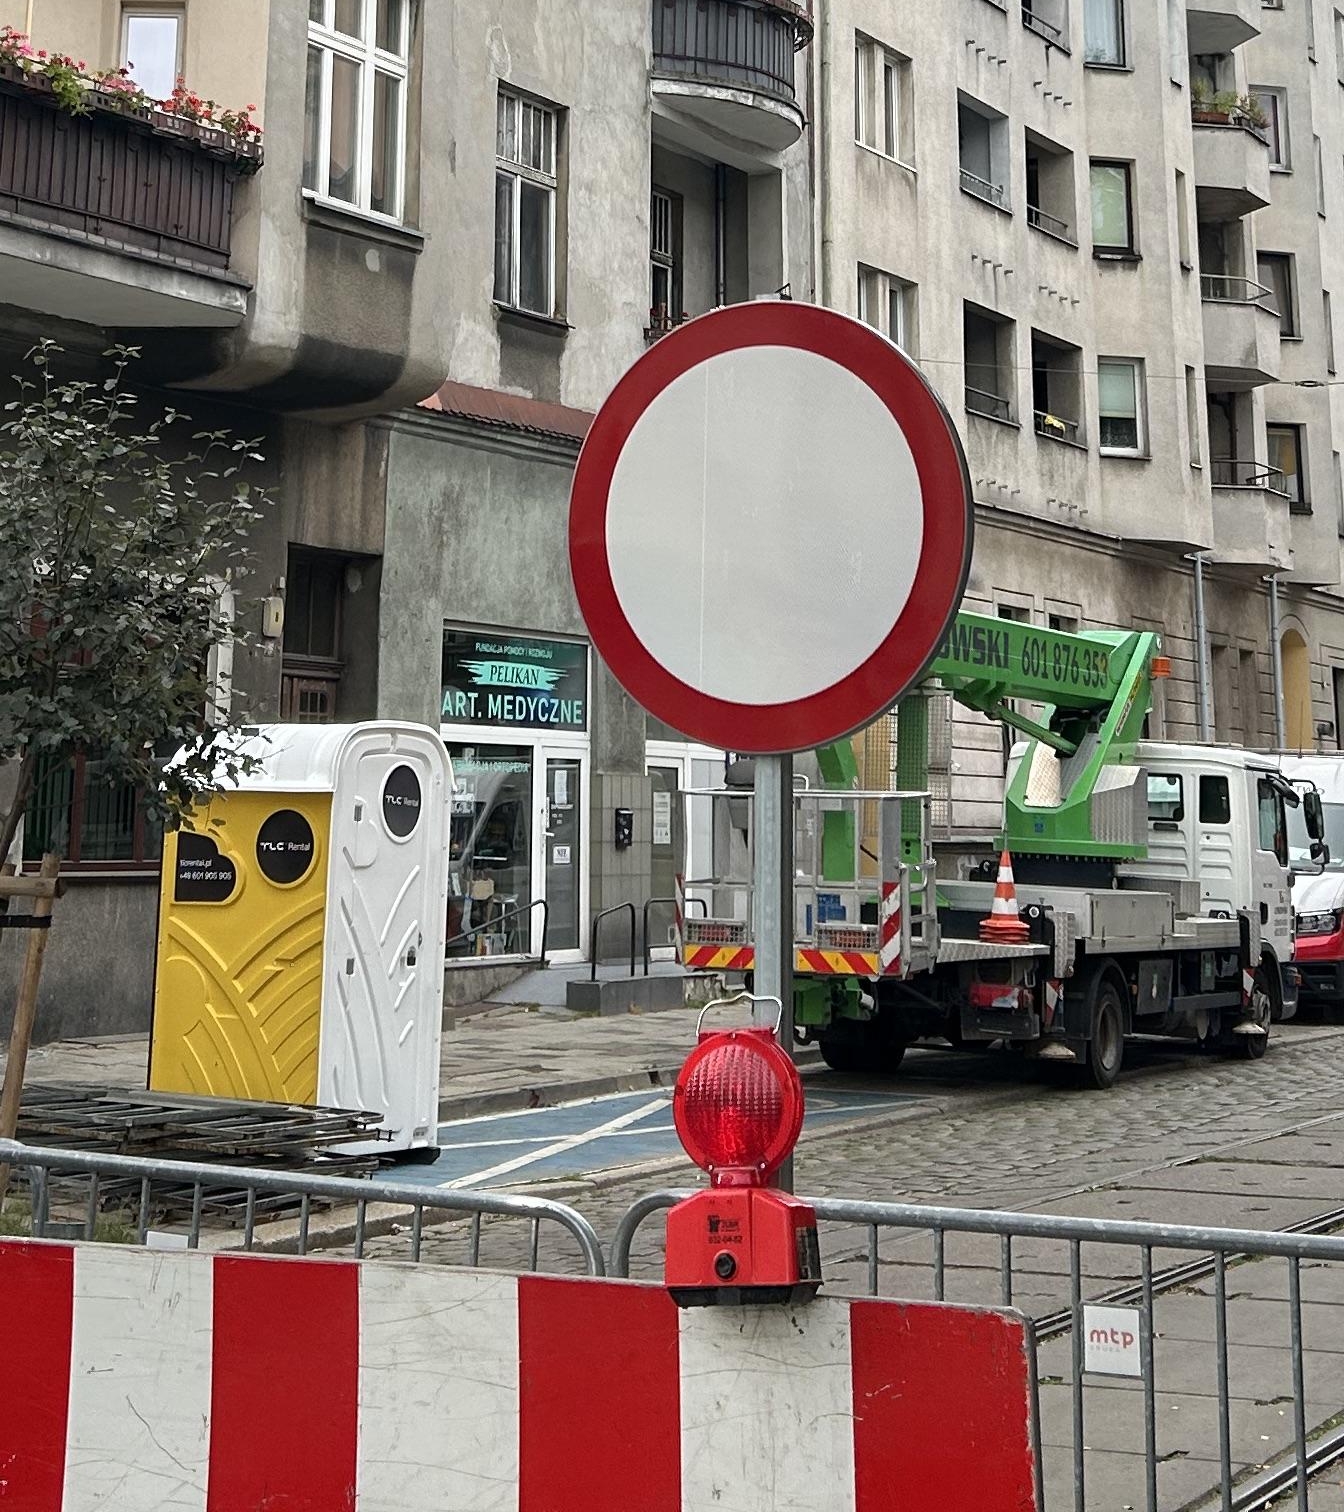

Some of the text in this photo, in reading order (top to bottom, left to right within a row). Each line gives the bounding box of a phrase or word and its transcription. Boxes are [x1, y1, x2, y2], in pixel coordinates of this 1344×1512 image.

[1021, 636, 1048, 679] 601
[1052, 641, 1080, 685] 876
[1083, 648, 1108, 689] 353
[489, 664, 540, 685] PELIKAN
[441, 690, 583, 724] ART. MEDYCZNE
[260, 841, 285, 851] TLC
[1090, 1327, 1134, 1349] mtp
